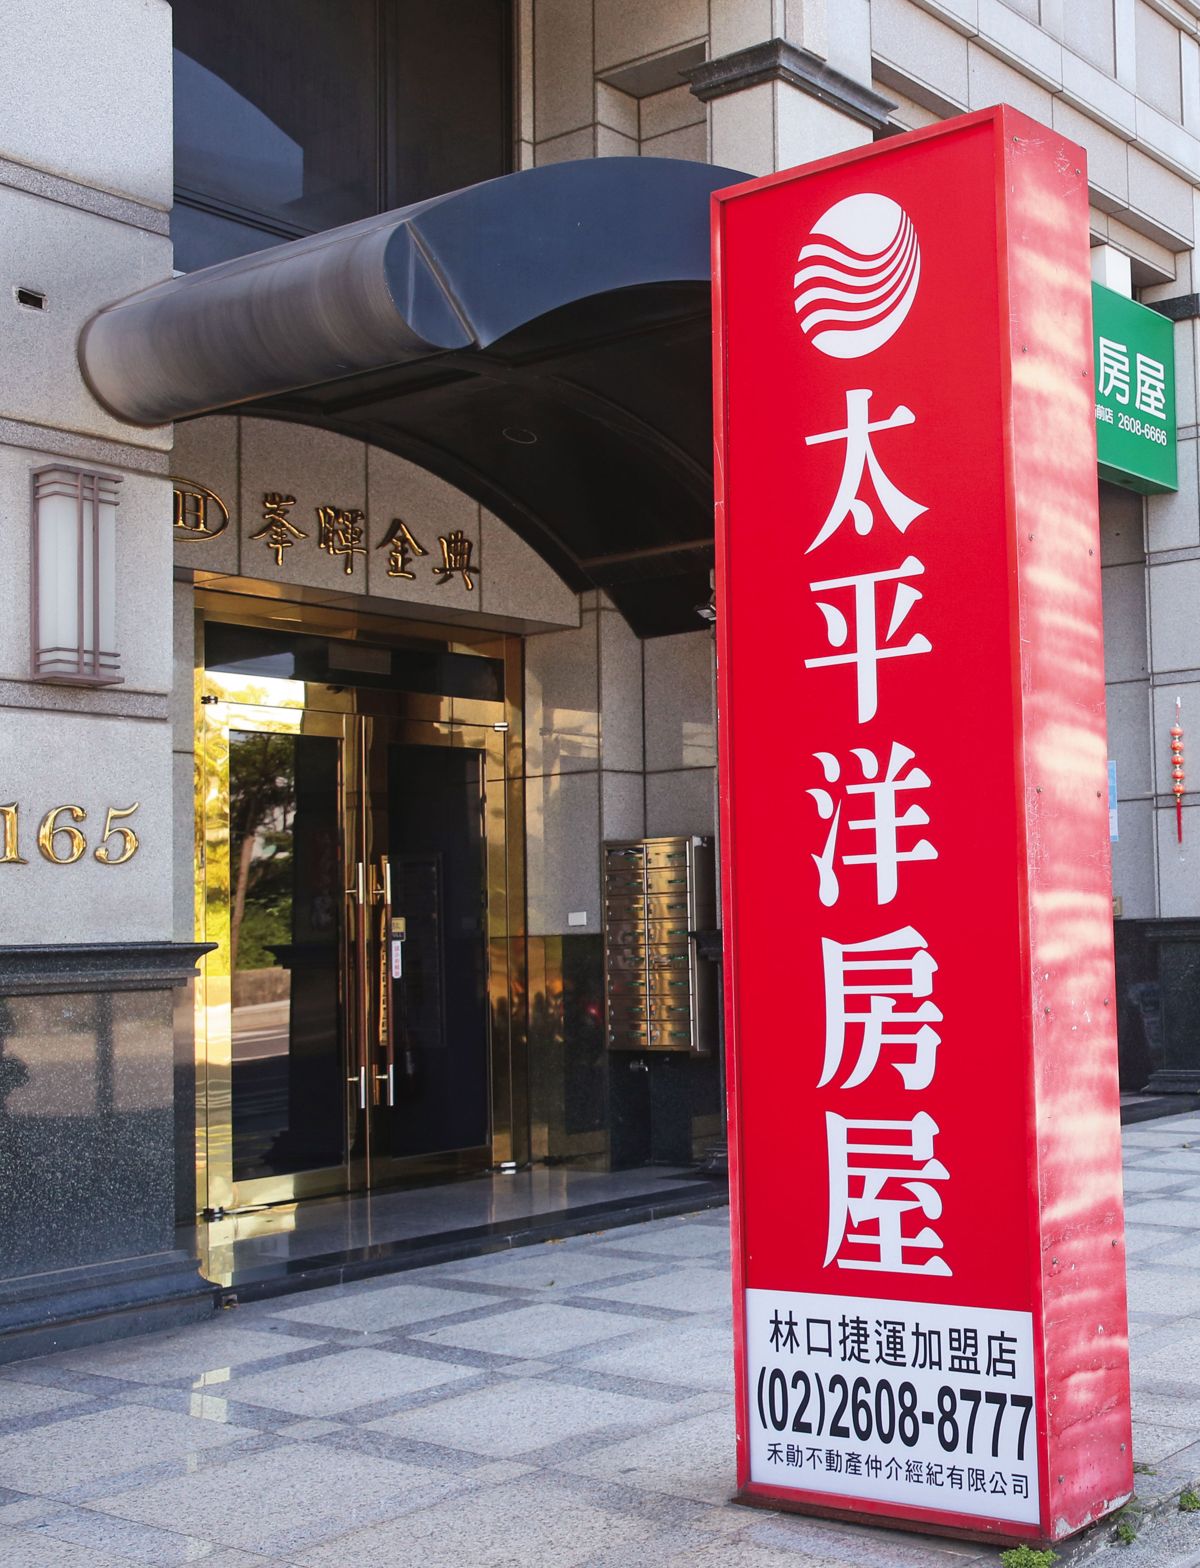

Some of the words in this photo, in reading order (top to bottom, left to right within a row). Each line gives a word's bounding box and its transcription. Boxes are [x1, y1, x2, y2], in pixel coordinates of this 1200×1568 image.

[1098, 336, 1166, 420] 房屋
[1118, 412, 1167, 446] 2608-6666
[0, 801, 139, 864] 165
[804, 388, 953, 1277] 太平洋房屋
[769, 1309, 1018, 1379] 林口捷運加盟店
[757, 1366, 1034, 1461] (02)2608-8777
[767, 1442, 1030, 1499] 禾勛不動產仲介經紀有限公司
